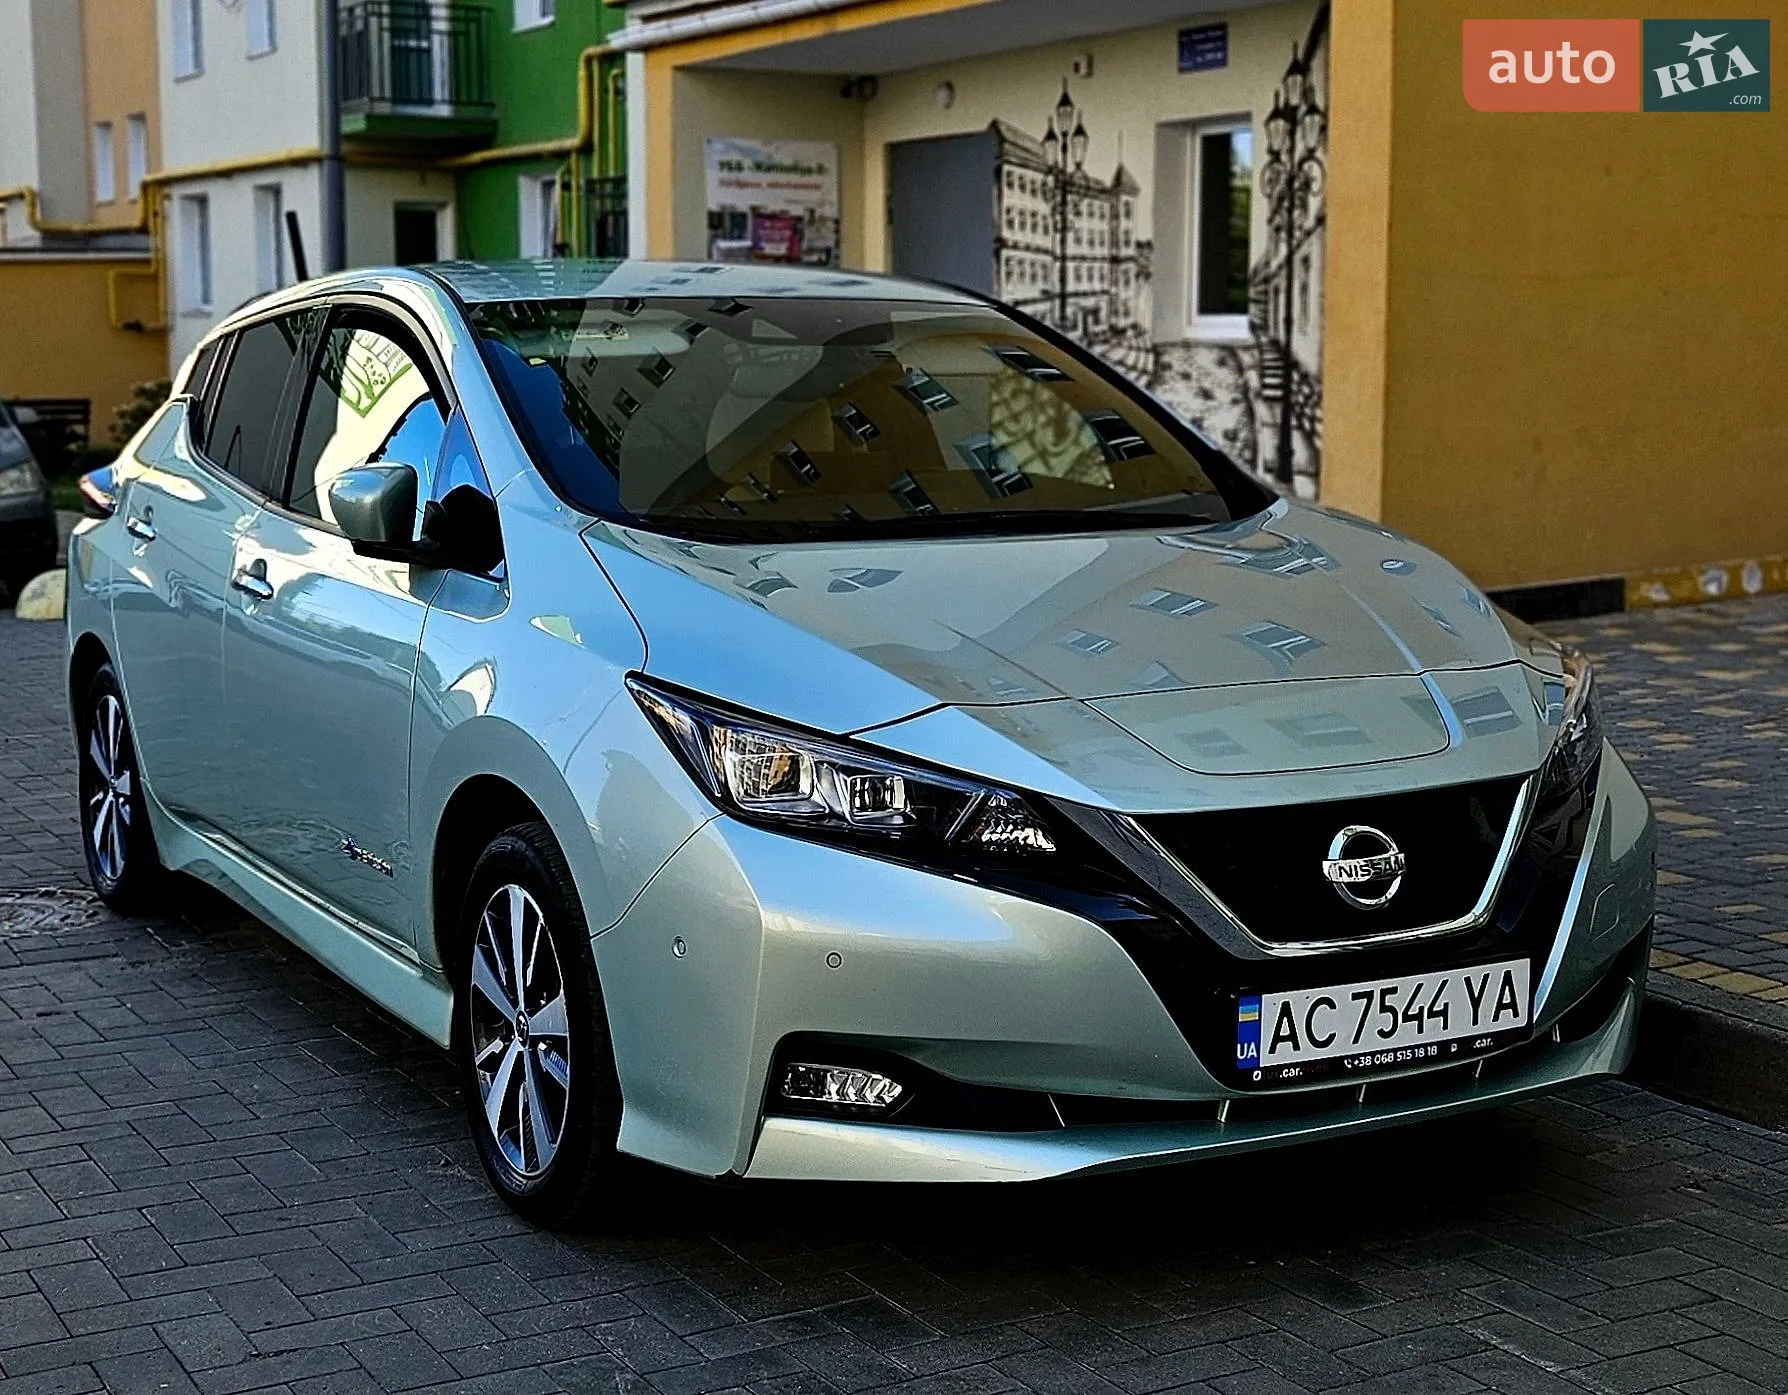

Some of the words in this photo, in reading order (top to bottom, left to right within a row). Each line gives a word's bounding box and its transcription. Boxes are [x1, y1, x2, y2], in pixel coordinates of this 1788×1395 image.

[1337, 854, 1405, 878] NISSAN
[1268, 996, 1337, 1055] AC
[1350, 978, 1450, 1045] 7544
[1463, 969, 1520, 1027] YA
[1236, 1041, 1258, 1060] UA
[1353, 1055, 1372, 1067] +38
[1374, 1052, 1394, 1064] 068
[1396, 1049, 1413, 1061] 515
[1414, 1047, 1425, 1058] 18
[1427, 1045, 1438, 1056] 18
